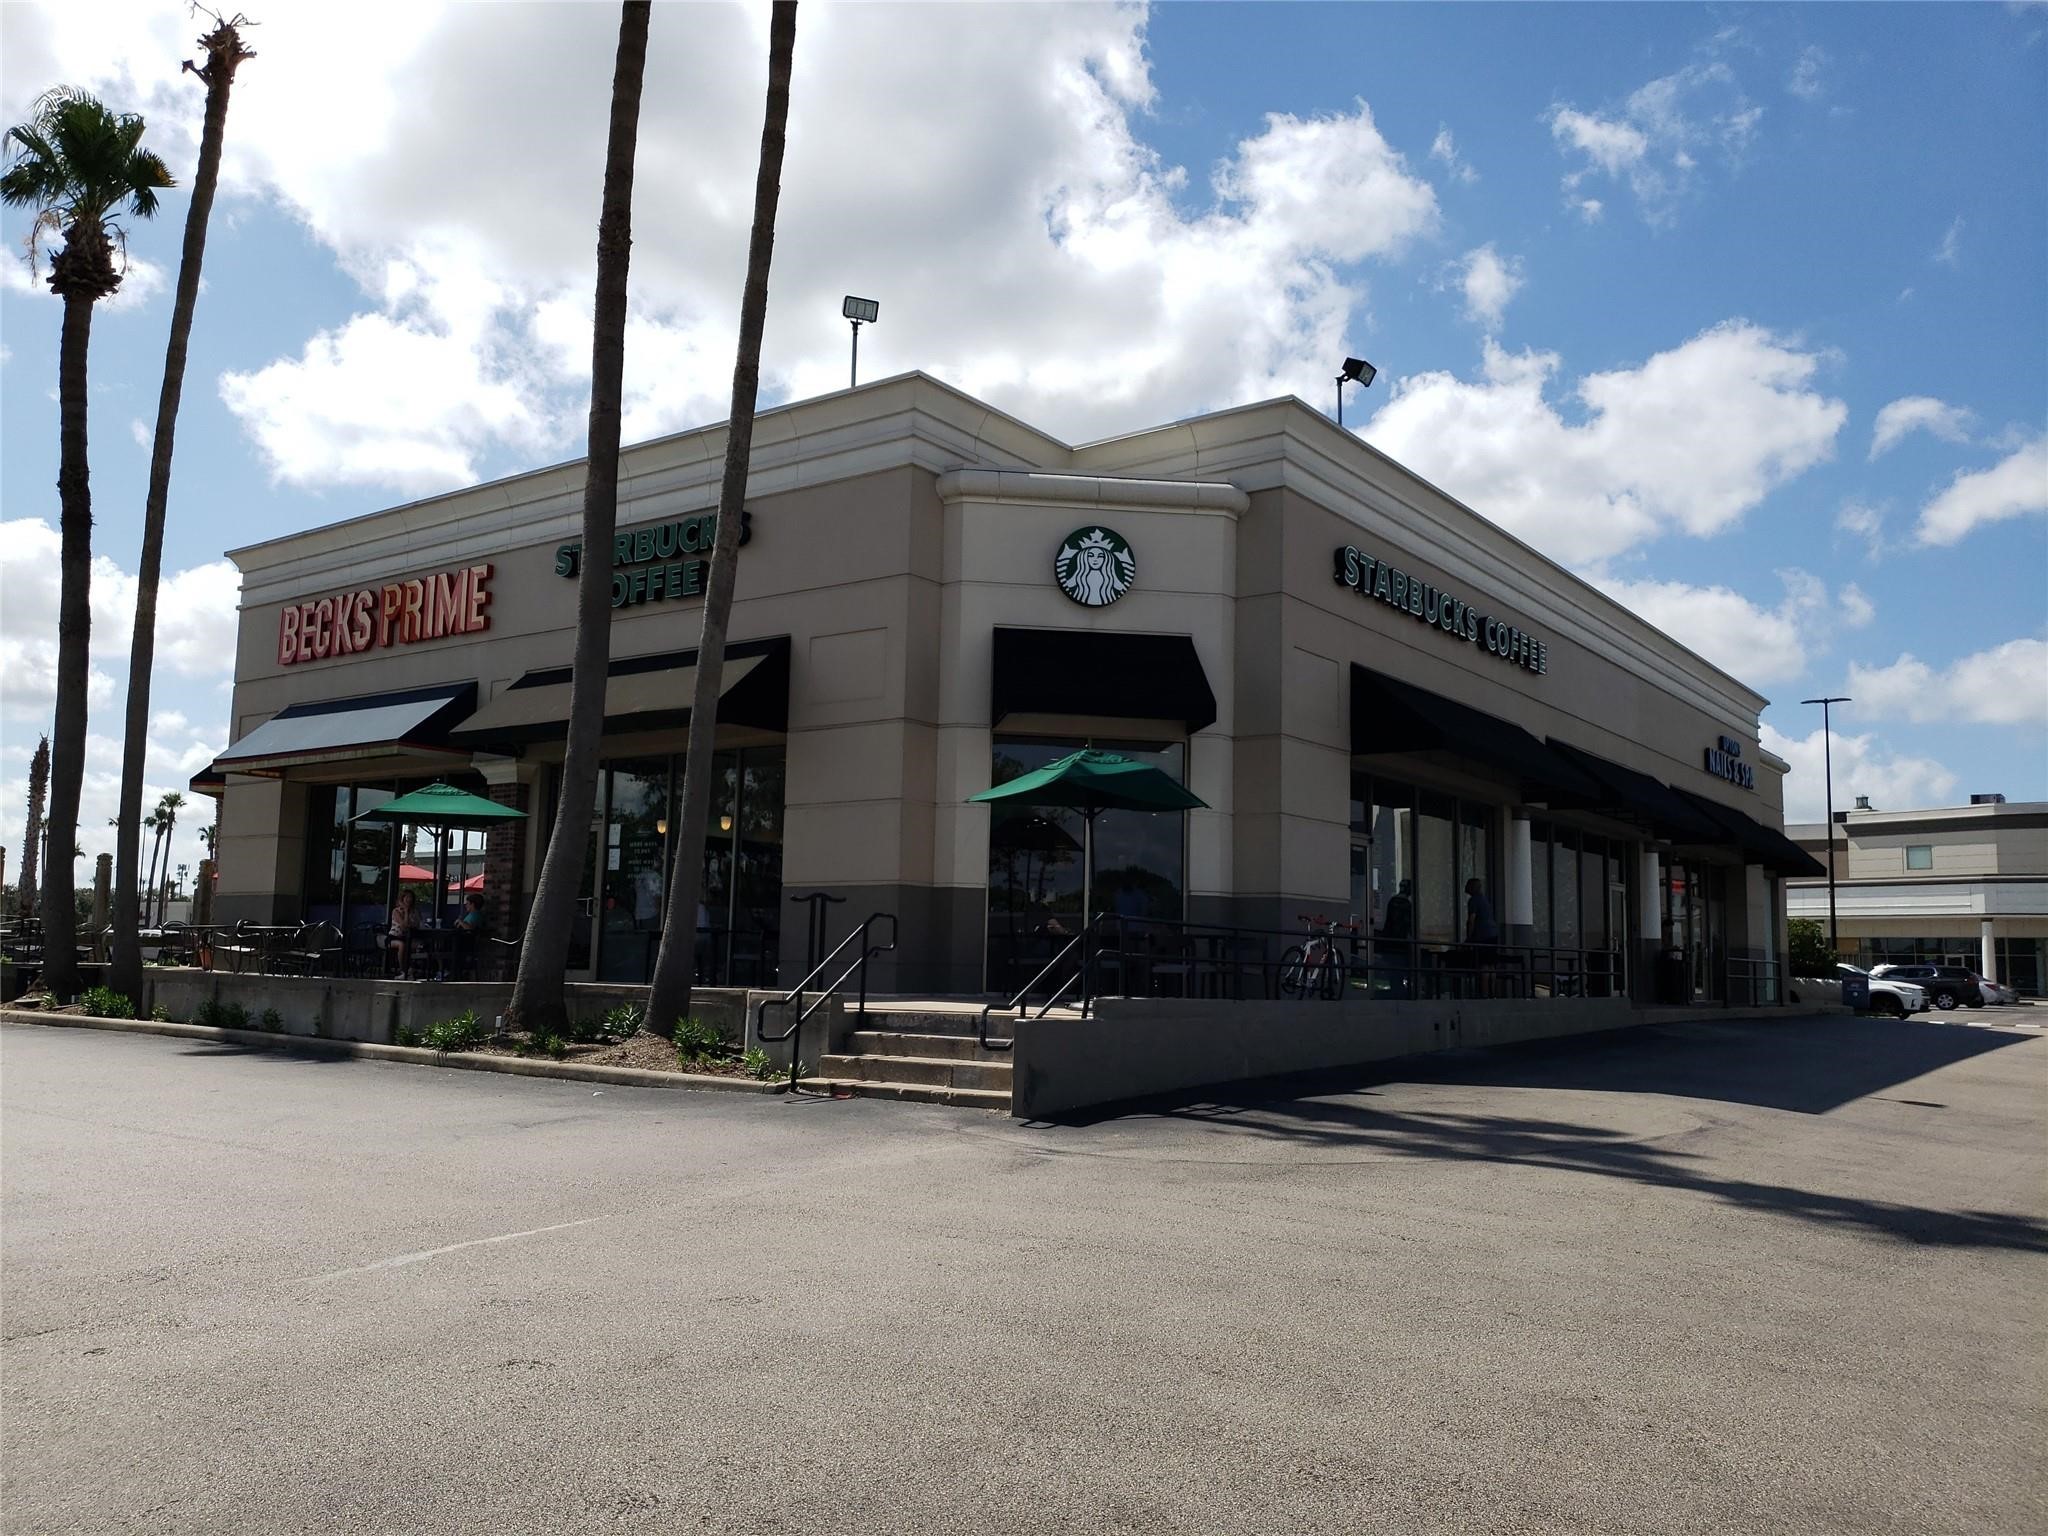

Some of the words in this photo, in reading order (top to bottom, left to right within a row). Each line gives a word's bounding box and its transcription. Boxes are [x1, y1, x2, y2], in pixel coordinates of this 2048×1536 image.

[278, 588, 377, 665] BECKS
[378, 563, 494, 648] PRIME
[609, 558, 704, 609] OFFEE
[1338, 545, 1479, 643] STARBUCKS
[1480, 614, 1548, 675] COFFEE
[1705, 748, 1733, 781] NAILS
